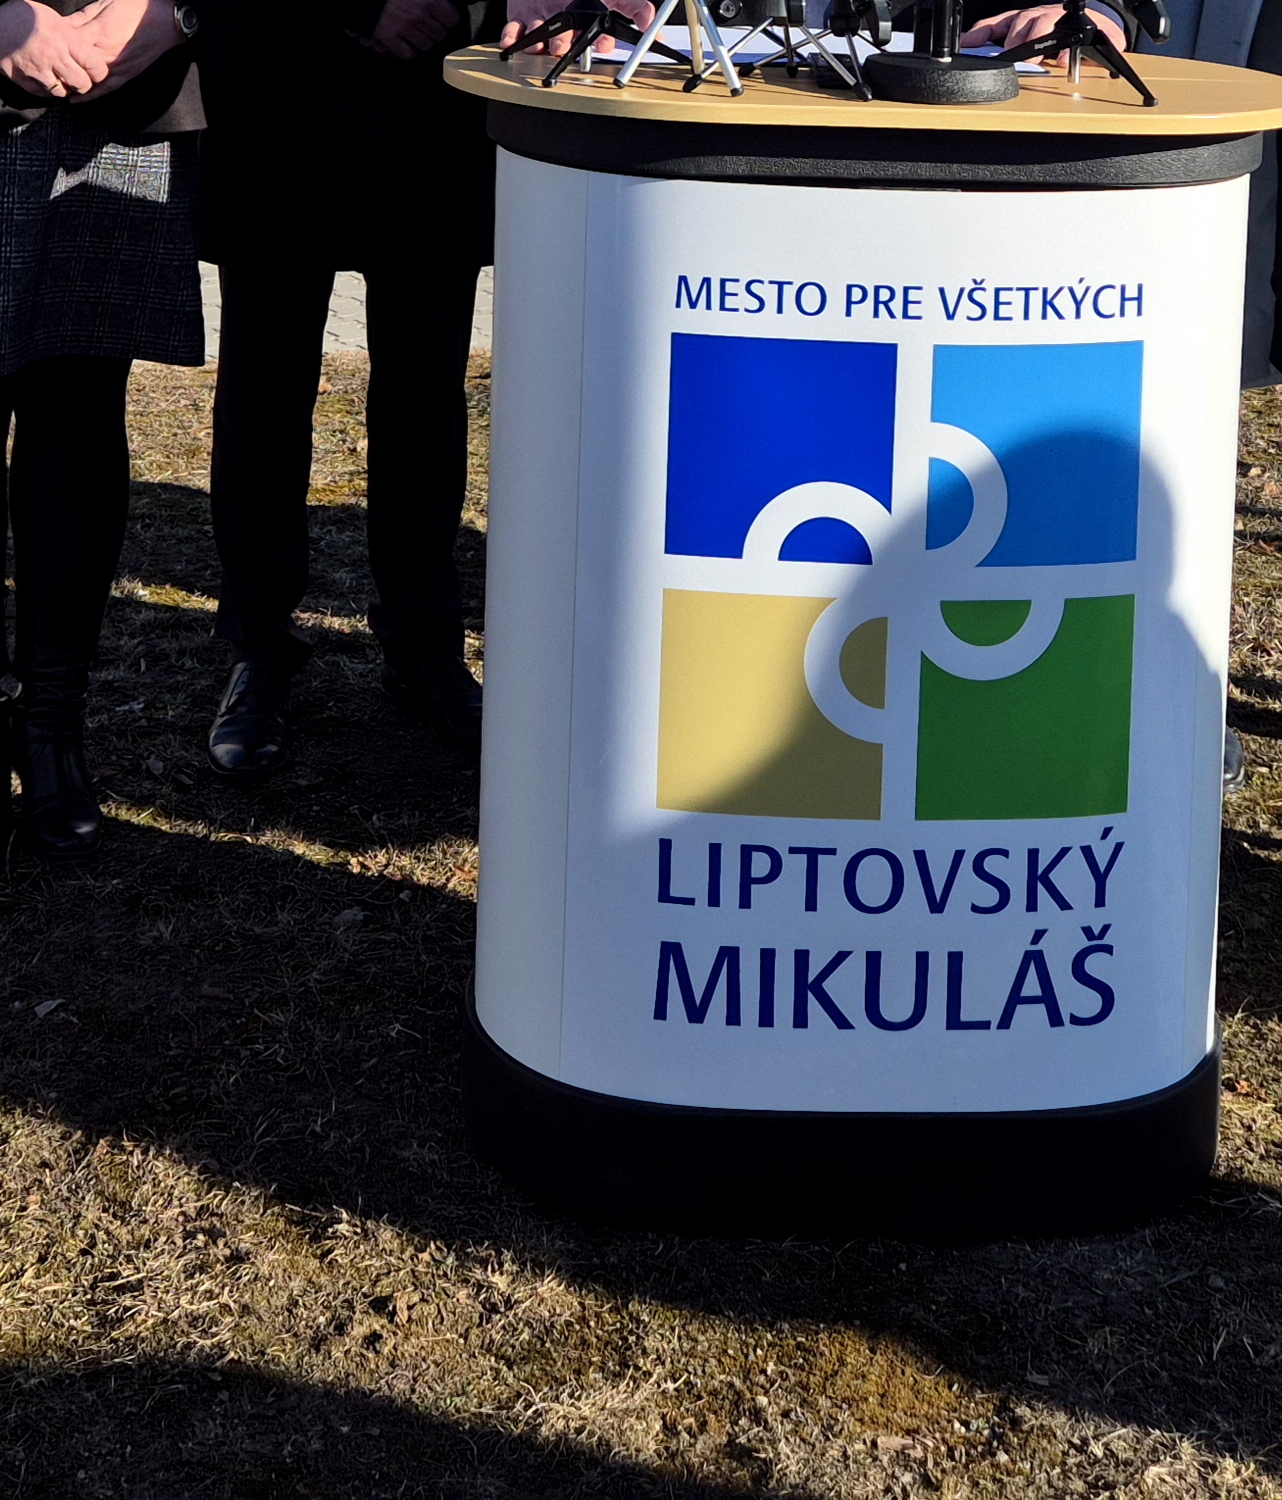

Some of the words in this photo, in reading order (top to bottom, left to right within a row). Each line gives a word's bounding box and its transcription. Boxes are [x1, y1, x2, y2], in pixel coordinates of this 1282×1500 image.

[676, 275, 827, 316] MESTO
[846, 284, 923, 319] PRE
[938, 278, 1142, 321] VŠETKÝCH
[658, 827, 1124, 914] LIPTOVSKÝ
[653, 924, 1115, 1031] MIKULÁŠ
